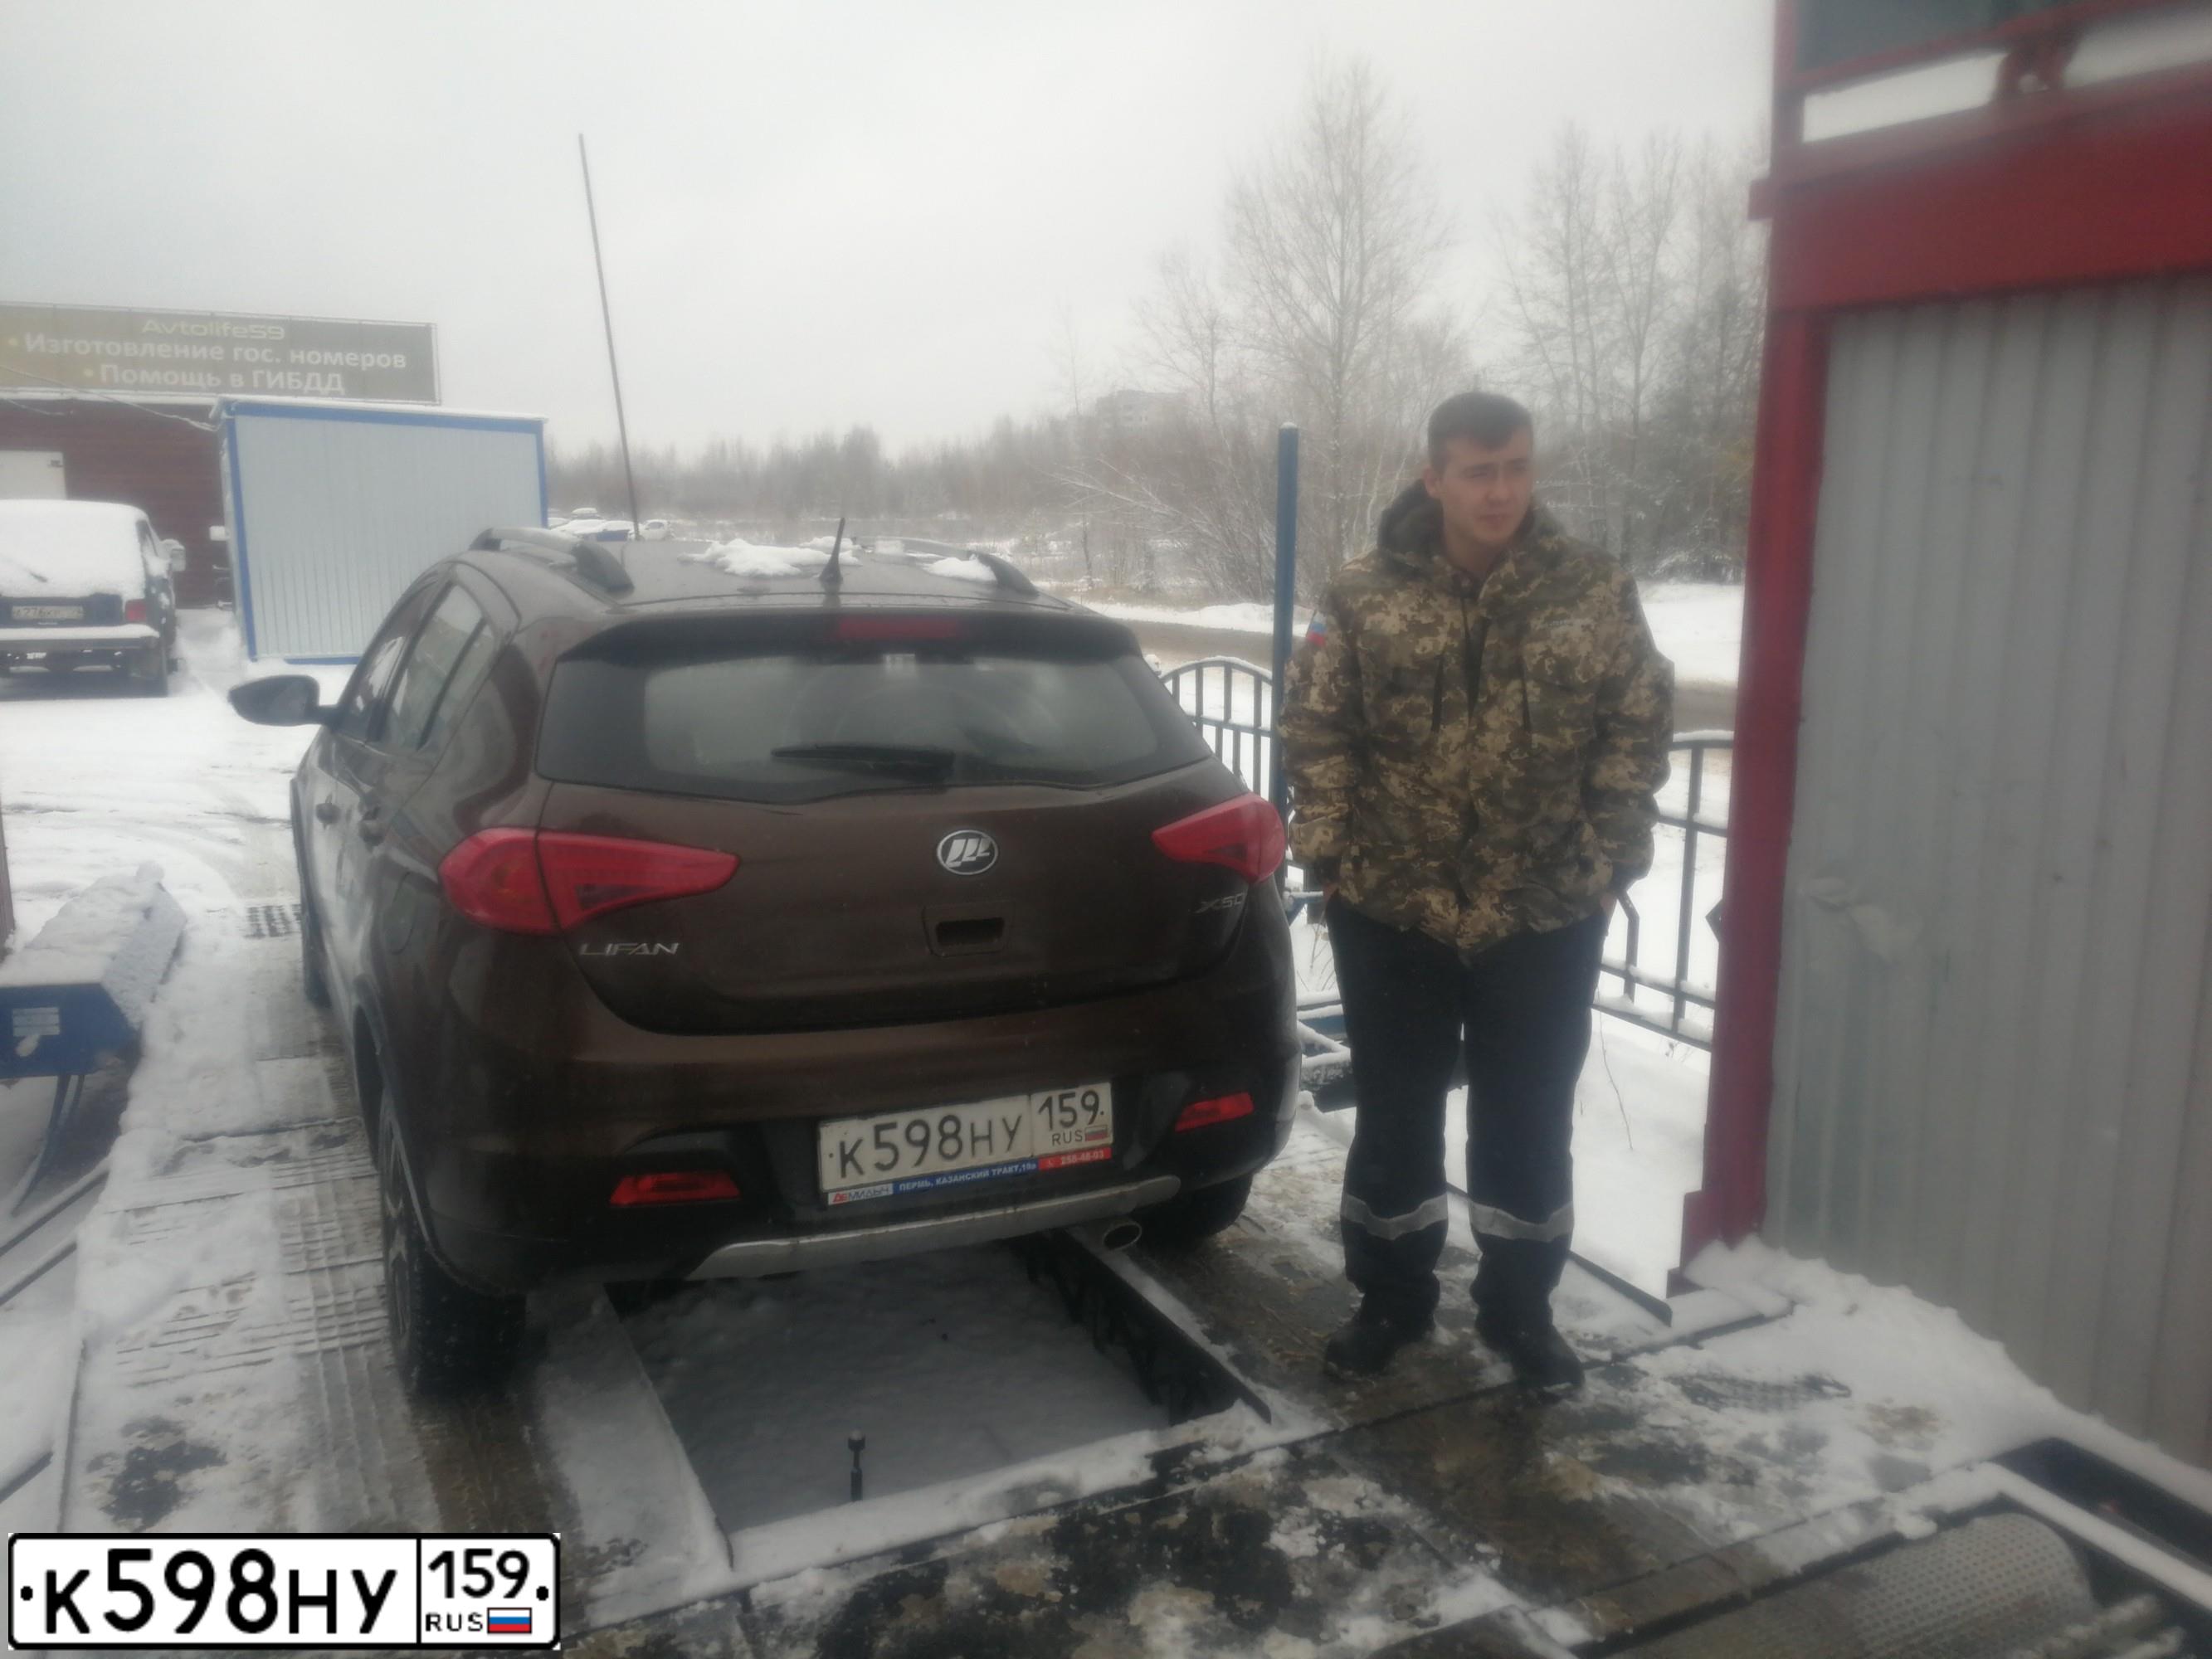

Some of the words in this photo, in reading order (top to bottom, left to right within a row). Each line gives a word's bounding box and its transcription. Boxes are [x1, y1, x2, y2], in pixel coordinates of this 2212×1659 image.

[24, 333, 224, 361] Изготовление
[233, 348, 281, 364] гос.
[290, 349, 406, 370] номеров
[100, 364, 221, 390] Помощь
[231, 372, 244, 387] в
[252, 369, 345, 396] ГИБДД
[579, 942, 680, 956] LIFAN
[1038, 1090, 1099, 1131] 159
[1051, 1129, 1084, 1146] RUS
